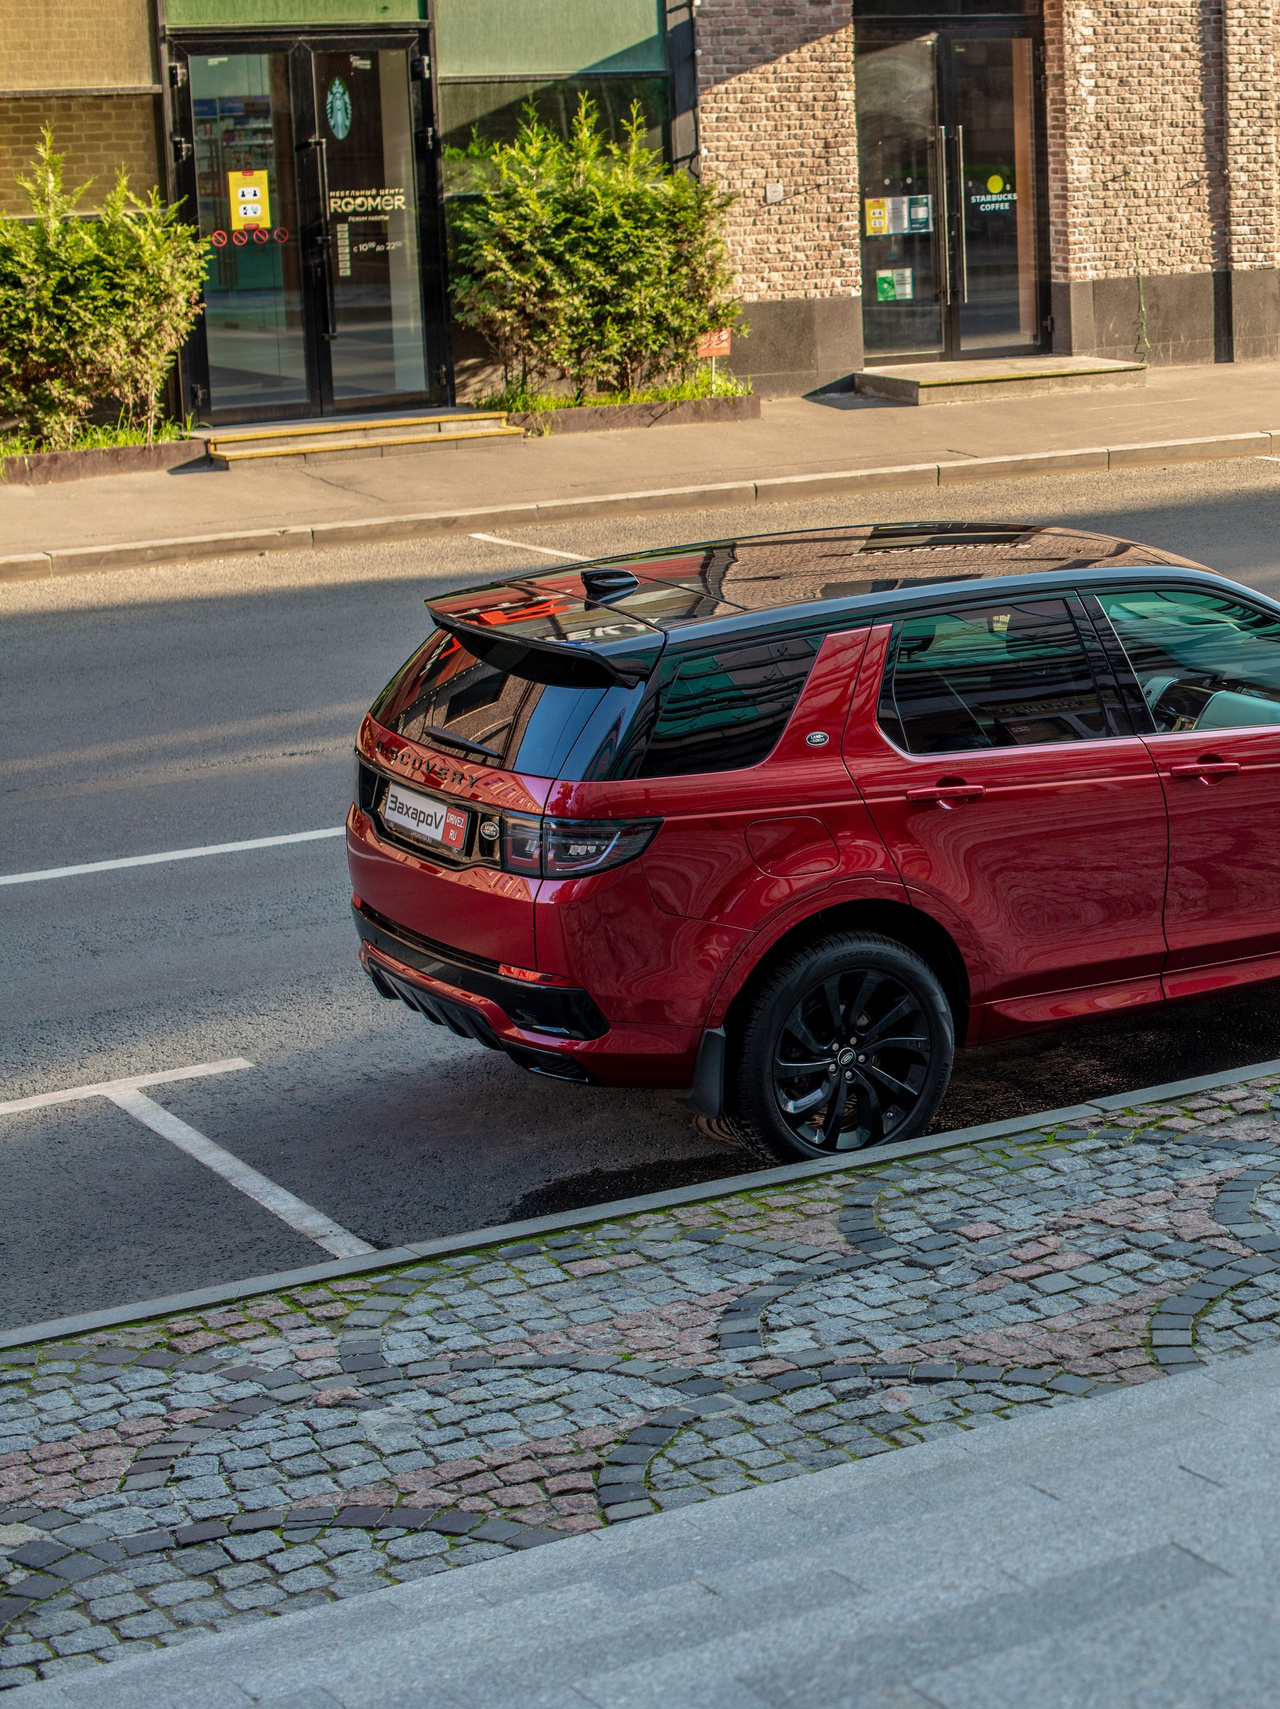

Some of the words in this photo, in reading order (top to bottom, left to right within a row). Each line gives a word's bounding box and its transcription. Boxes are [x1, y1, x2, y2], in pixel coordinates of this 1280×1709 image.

[330, 188, 377, 197] МЕБЕЛЬНЫЙ
[379, 188, 405, 196] ЦЕНТР
[971, 193, 1018, 203] STARBUCKS
[980, 202, 1010, 211] COFFEE
[375, 740, 481, 788] DISCOVERY
[449, 829, 458, 841] RU
